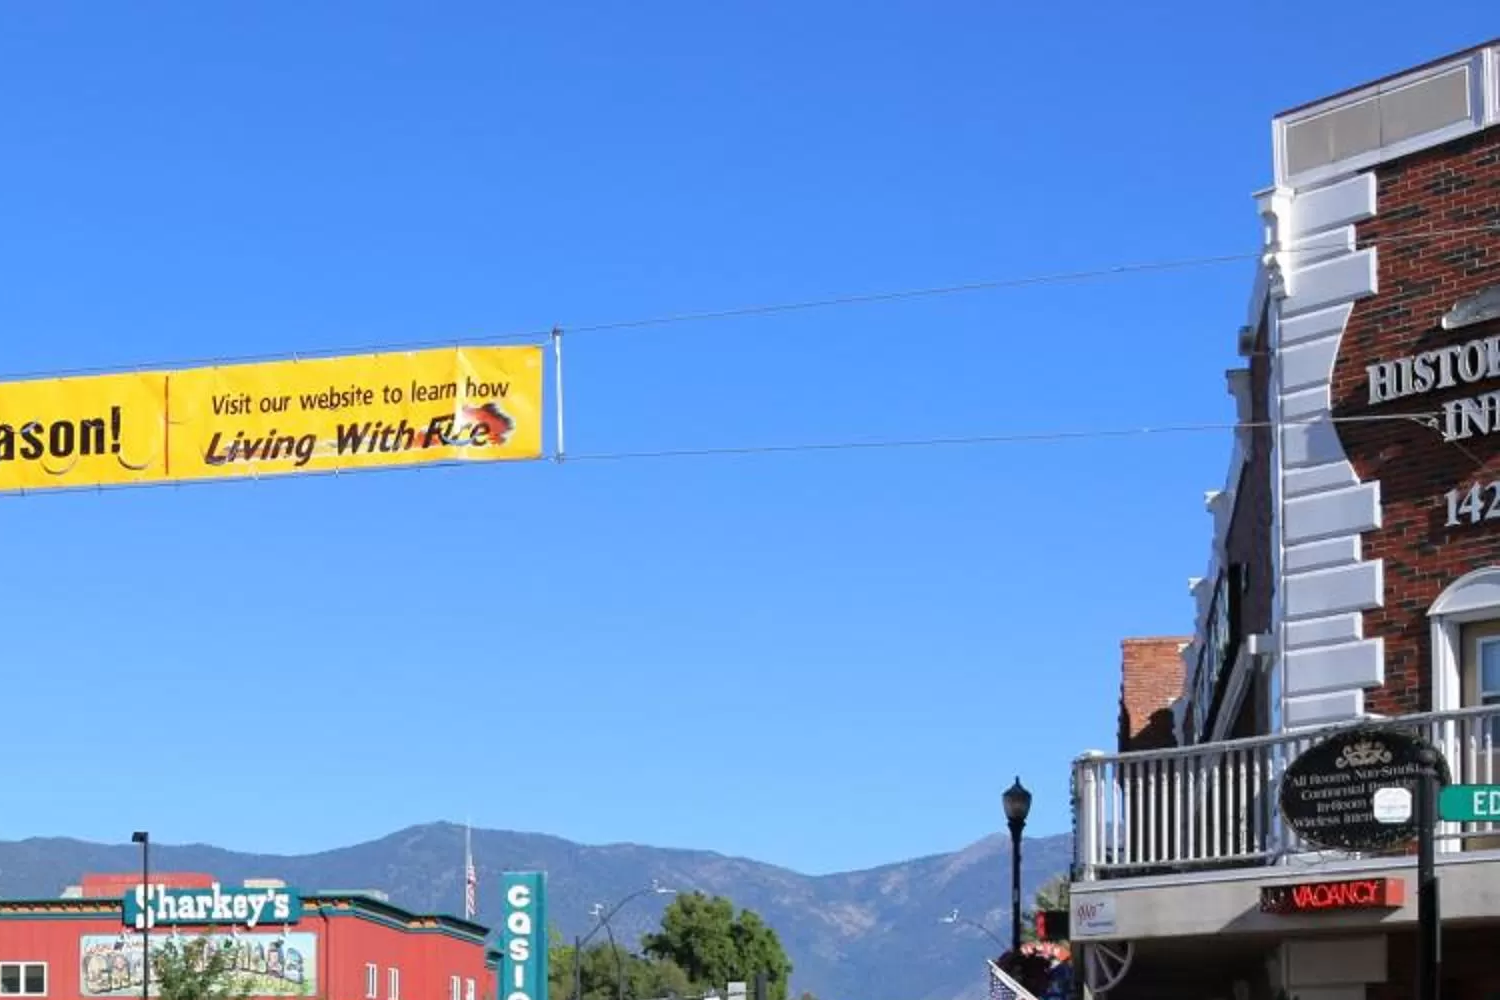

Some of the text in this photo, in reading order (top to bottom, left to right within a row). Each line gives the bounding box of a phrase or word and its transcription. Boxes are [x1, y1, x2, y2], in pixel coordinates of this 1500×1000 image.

[211, 376, 510, 415] Visit our website to learn how
[203, 426, 317, 466] Living
[336, 416, 415, 454] With
[135, 882, 290, 929] Sharkey's
[1293, 879, 1377, 908] VACANCY
